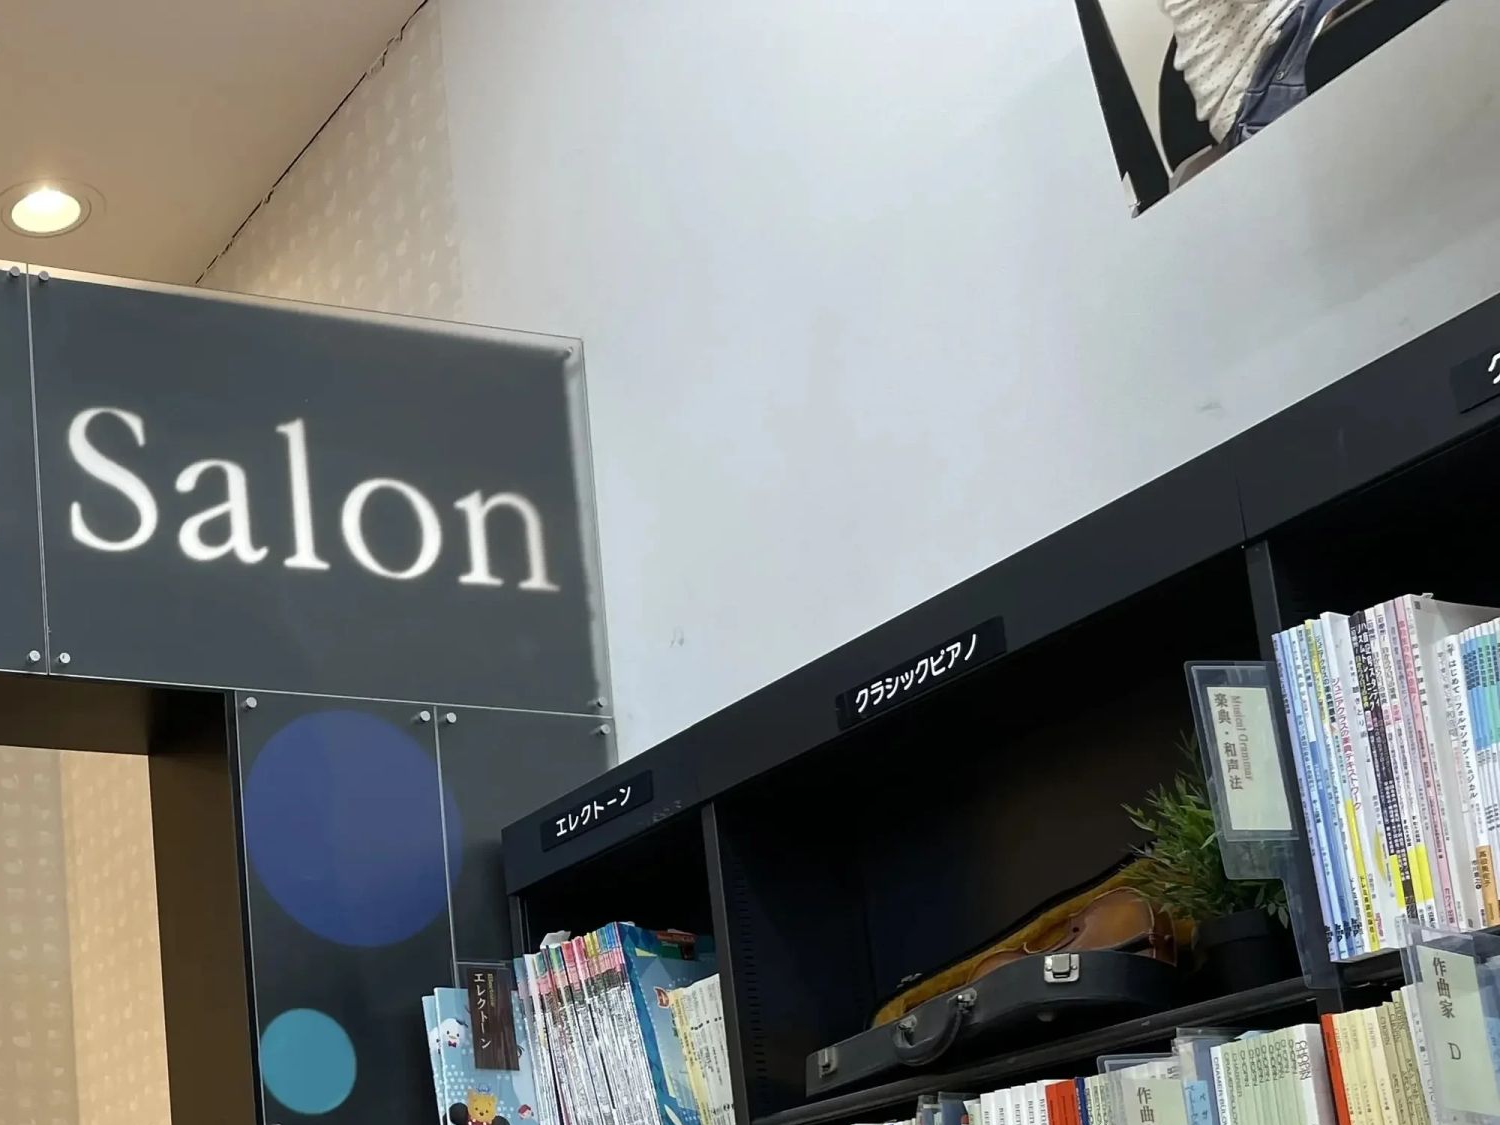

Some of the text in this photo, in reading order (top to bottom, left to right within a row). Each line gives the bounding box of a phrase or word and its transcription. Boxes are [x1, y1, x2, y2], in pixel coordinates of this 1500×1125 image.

[68, 406, 561, 592] Salon
[856, 634, 977, 714] クラシックピアノ
[556, 786, 631, 838] エレクトーン
[473, 972, 491, 1050] エレクトーン
[1432, 957, 1462, 1060] 作曲家 D
